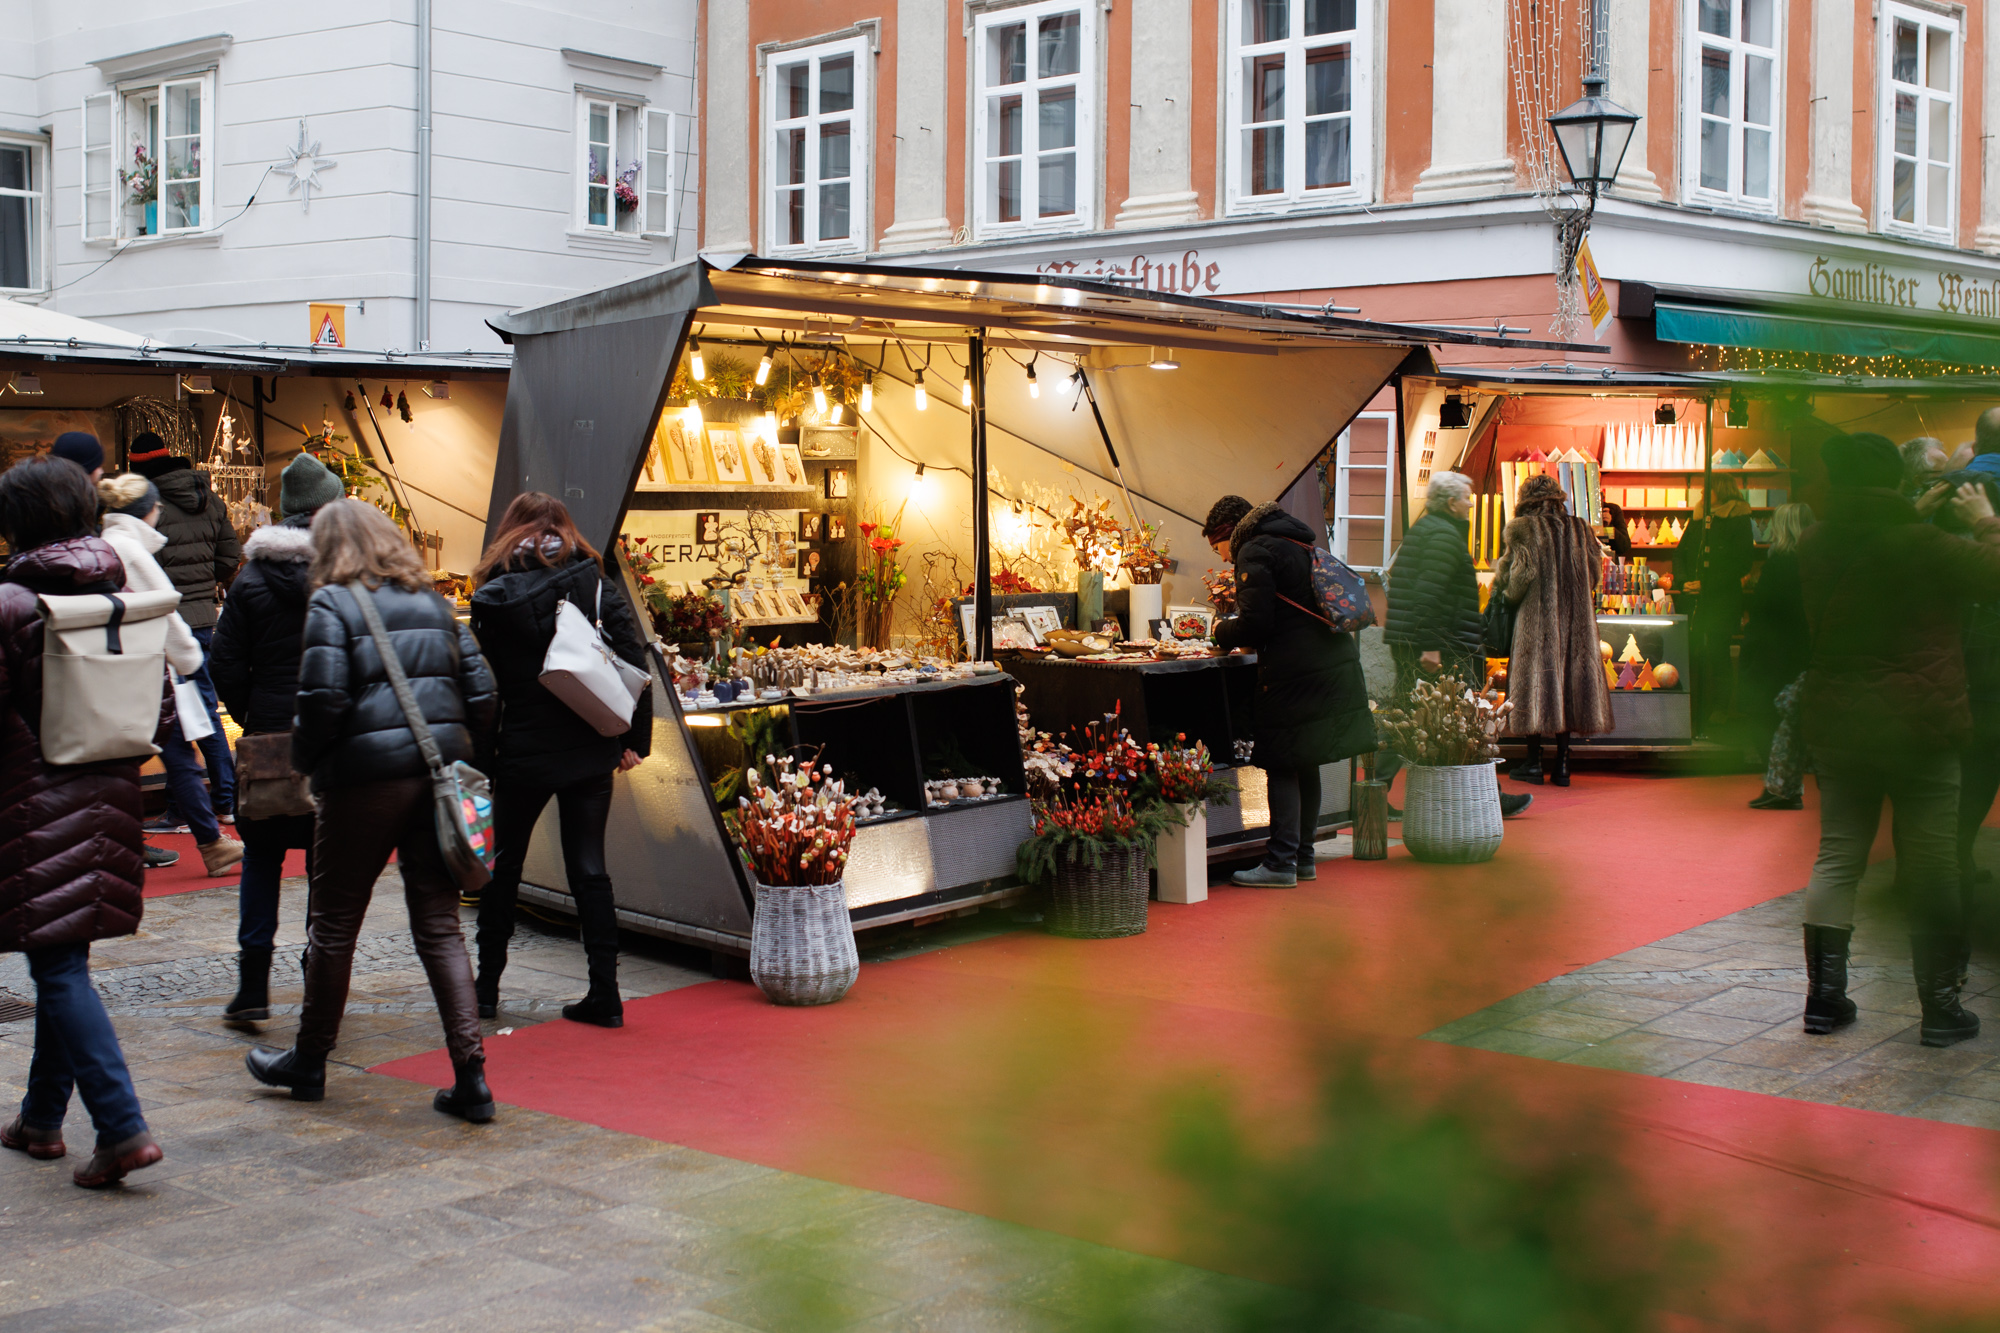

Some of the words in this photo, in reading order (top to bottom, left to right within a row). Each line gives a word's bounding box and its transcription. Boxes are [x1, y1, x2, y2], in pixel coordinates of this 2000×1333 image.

[1808, 256, 1920, 308] Gamlitzer
[1938, 272, 2000, 319] Weins
[646, 544, 754, 562] KERAM
